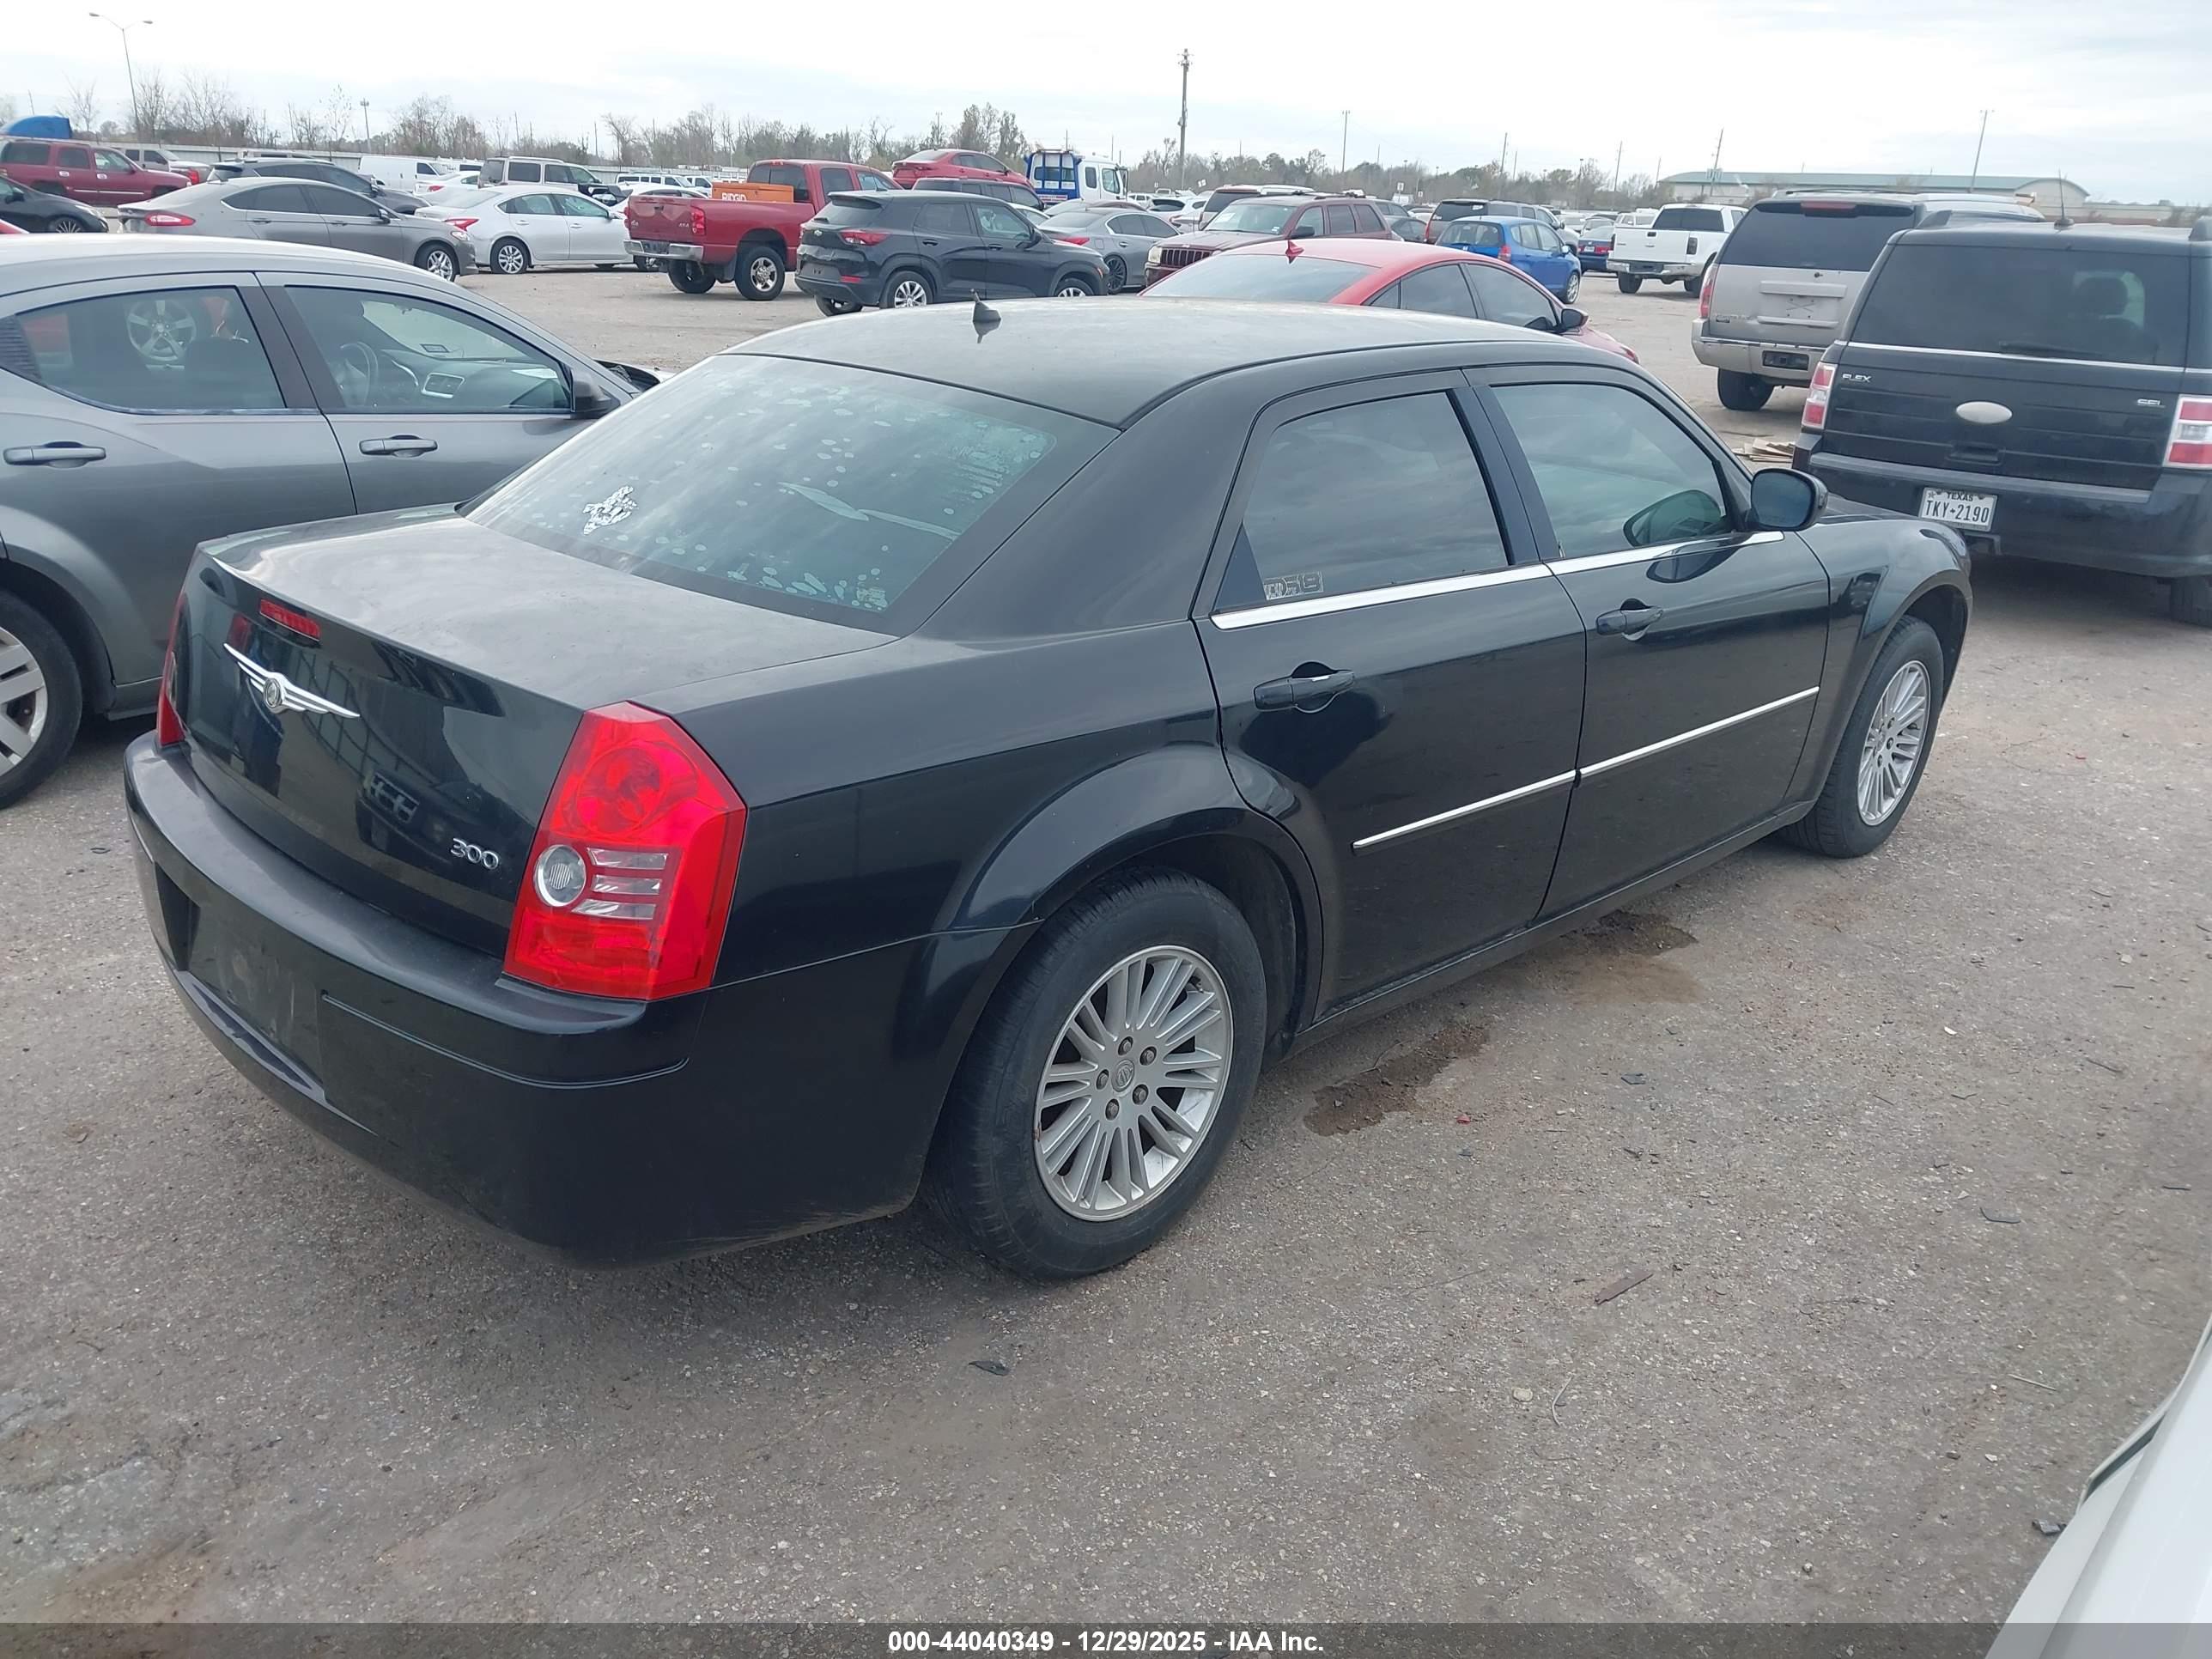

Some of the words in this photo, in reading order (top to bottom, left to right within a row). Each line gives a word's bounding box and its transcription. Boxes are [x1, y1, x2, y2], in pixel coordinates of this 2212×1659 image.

[721, 191, 747, 201] RIDGID
[1842, 373, 1872, 383] FLEX
[1947, 491, 1974, 502] TEXAS
[451, 837, 499, 870] 300
